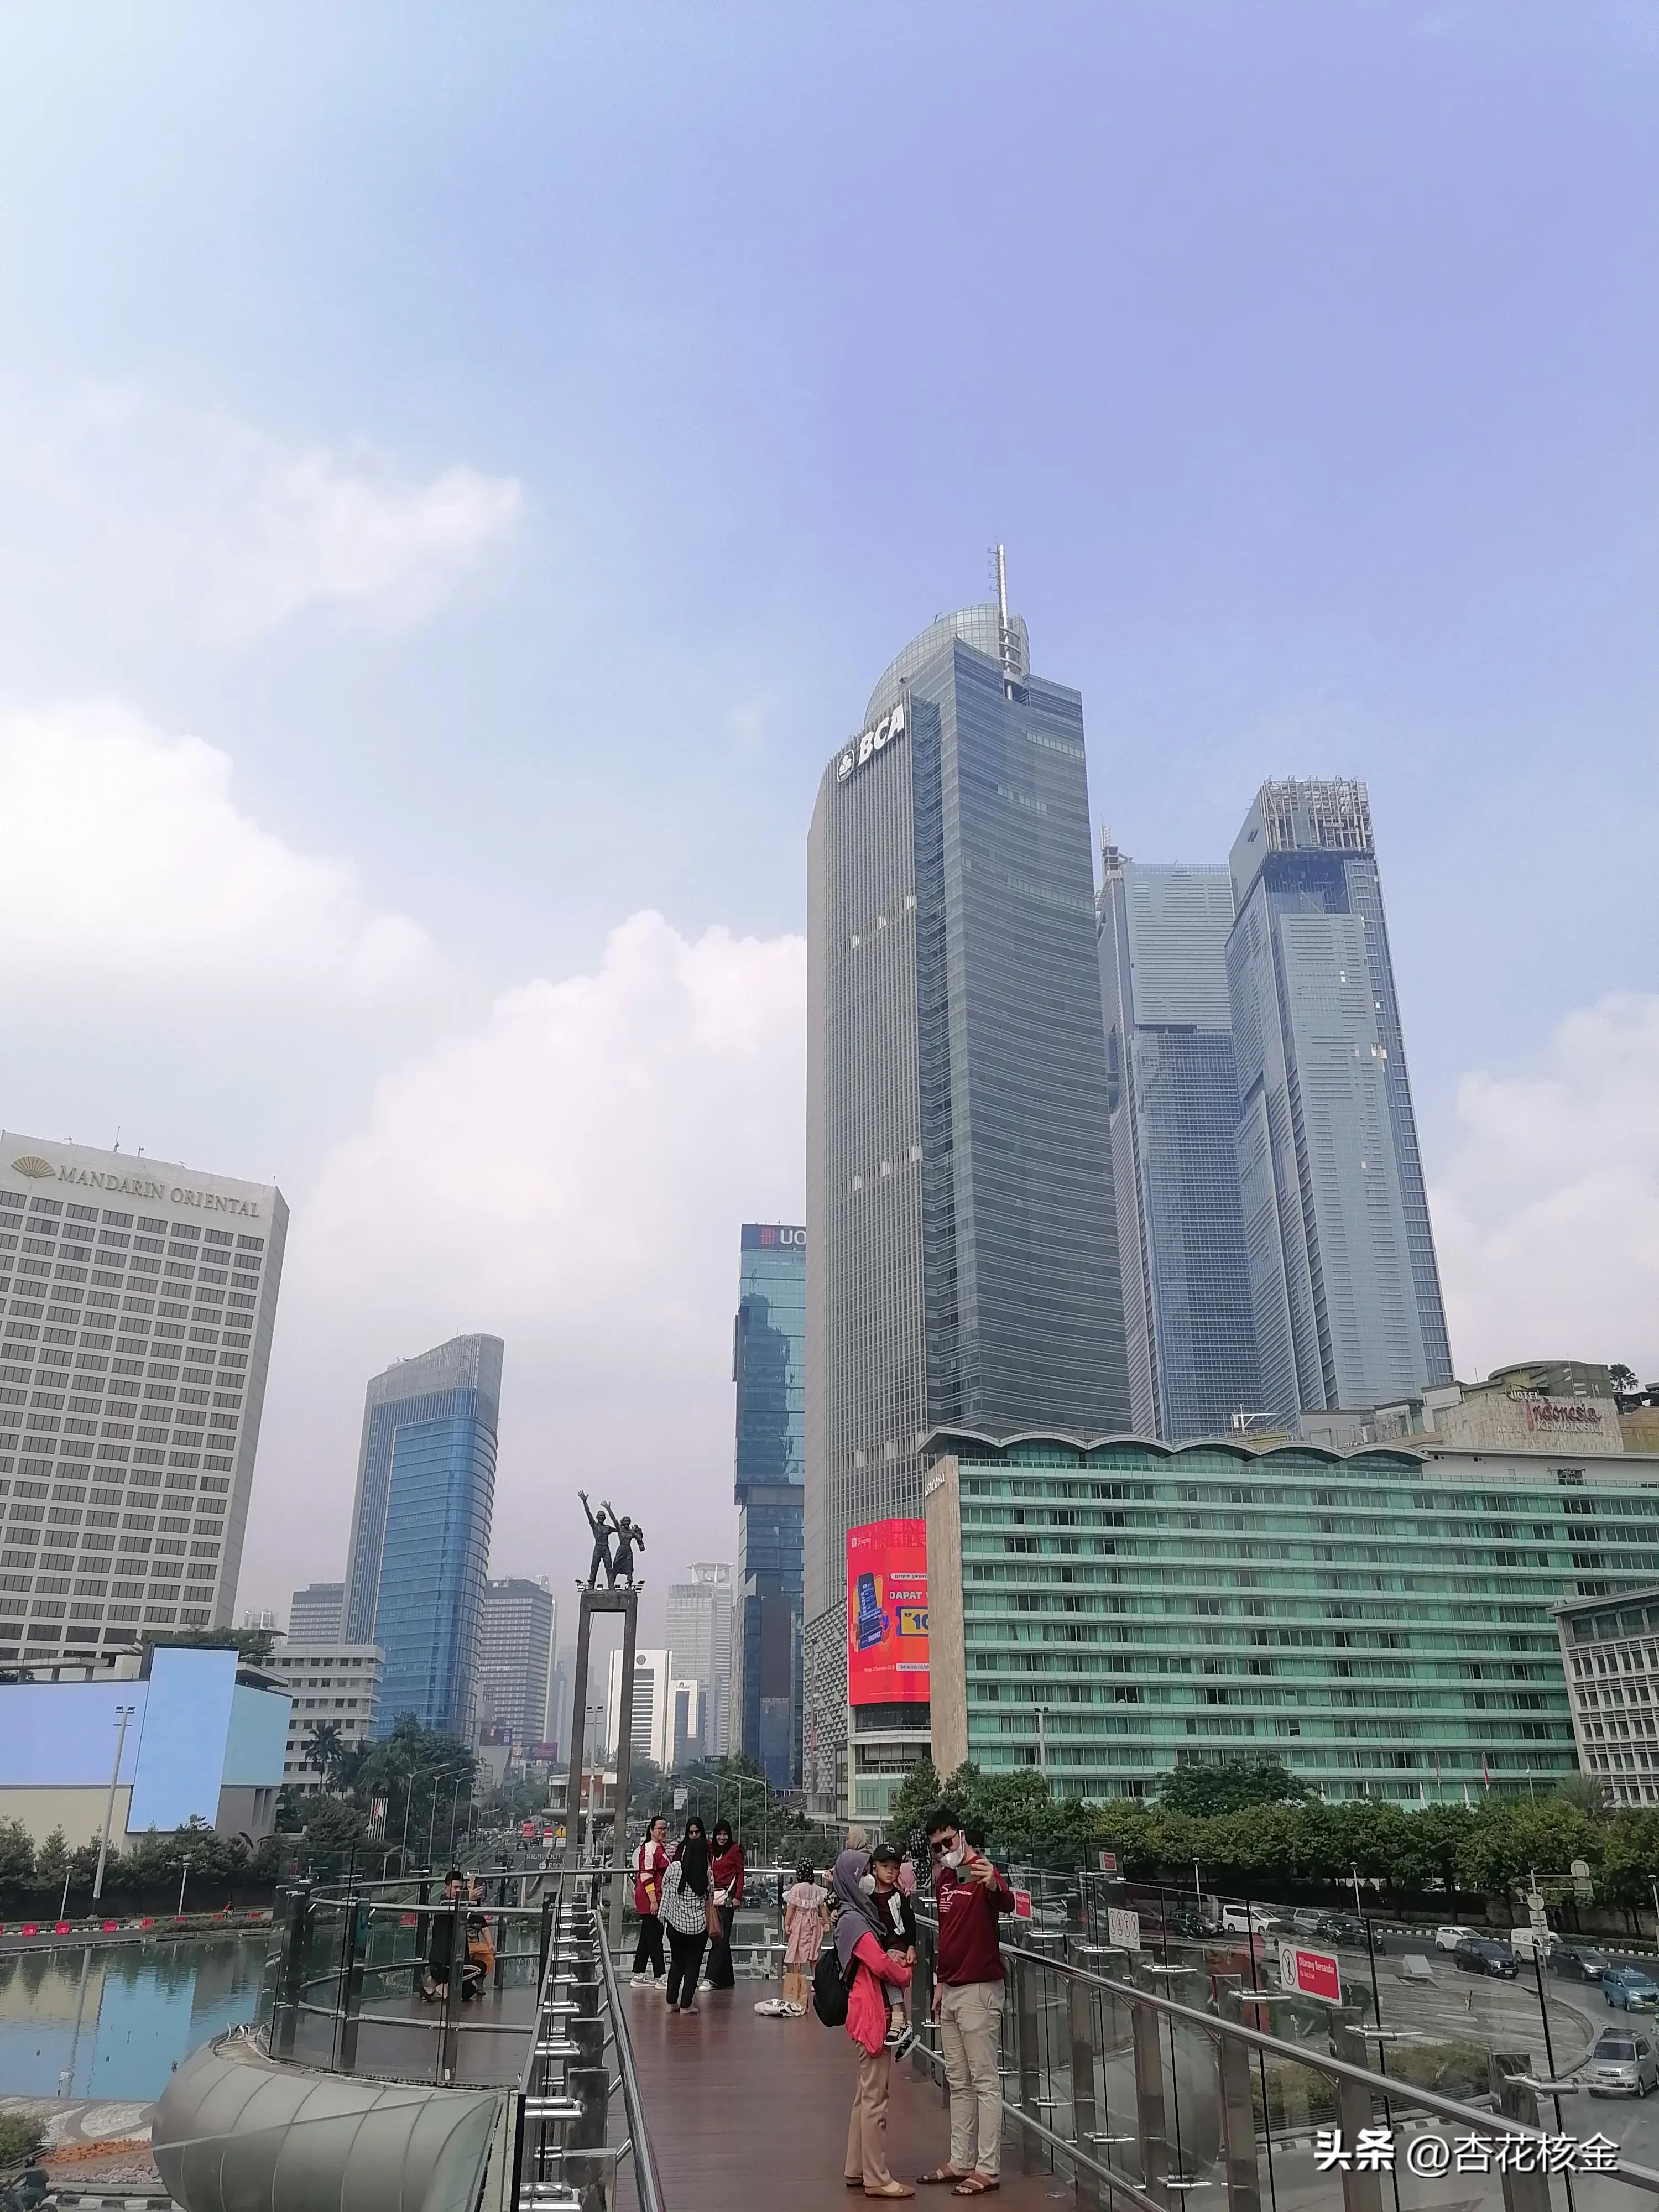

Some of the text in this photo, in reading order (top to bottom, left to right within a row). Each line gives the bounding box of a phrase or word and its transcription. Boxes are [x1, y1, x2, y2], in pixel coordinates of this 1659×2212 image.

[858, 704, 905, 766] BCA
[58, 1165, 260, 1218] MANDARIN ORIENTAL
[1510, 1390, 1541, 1400] HOTEL
[1525, 1396, 1601, 1432] Indonesia
[1537, 1421, 1603, 1433] KEMPINSKI
[889, 1591, 922, 1599] DAPAT
